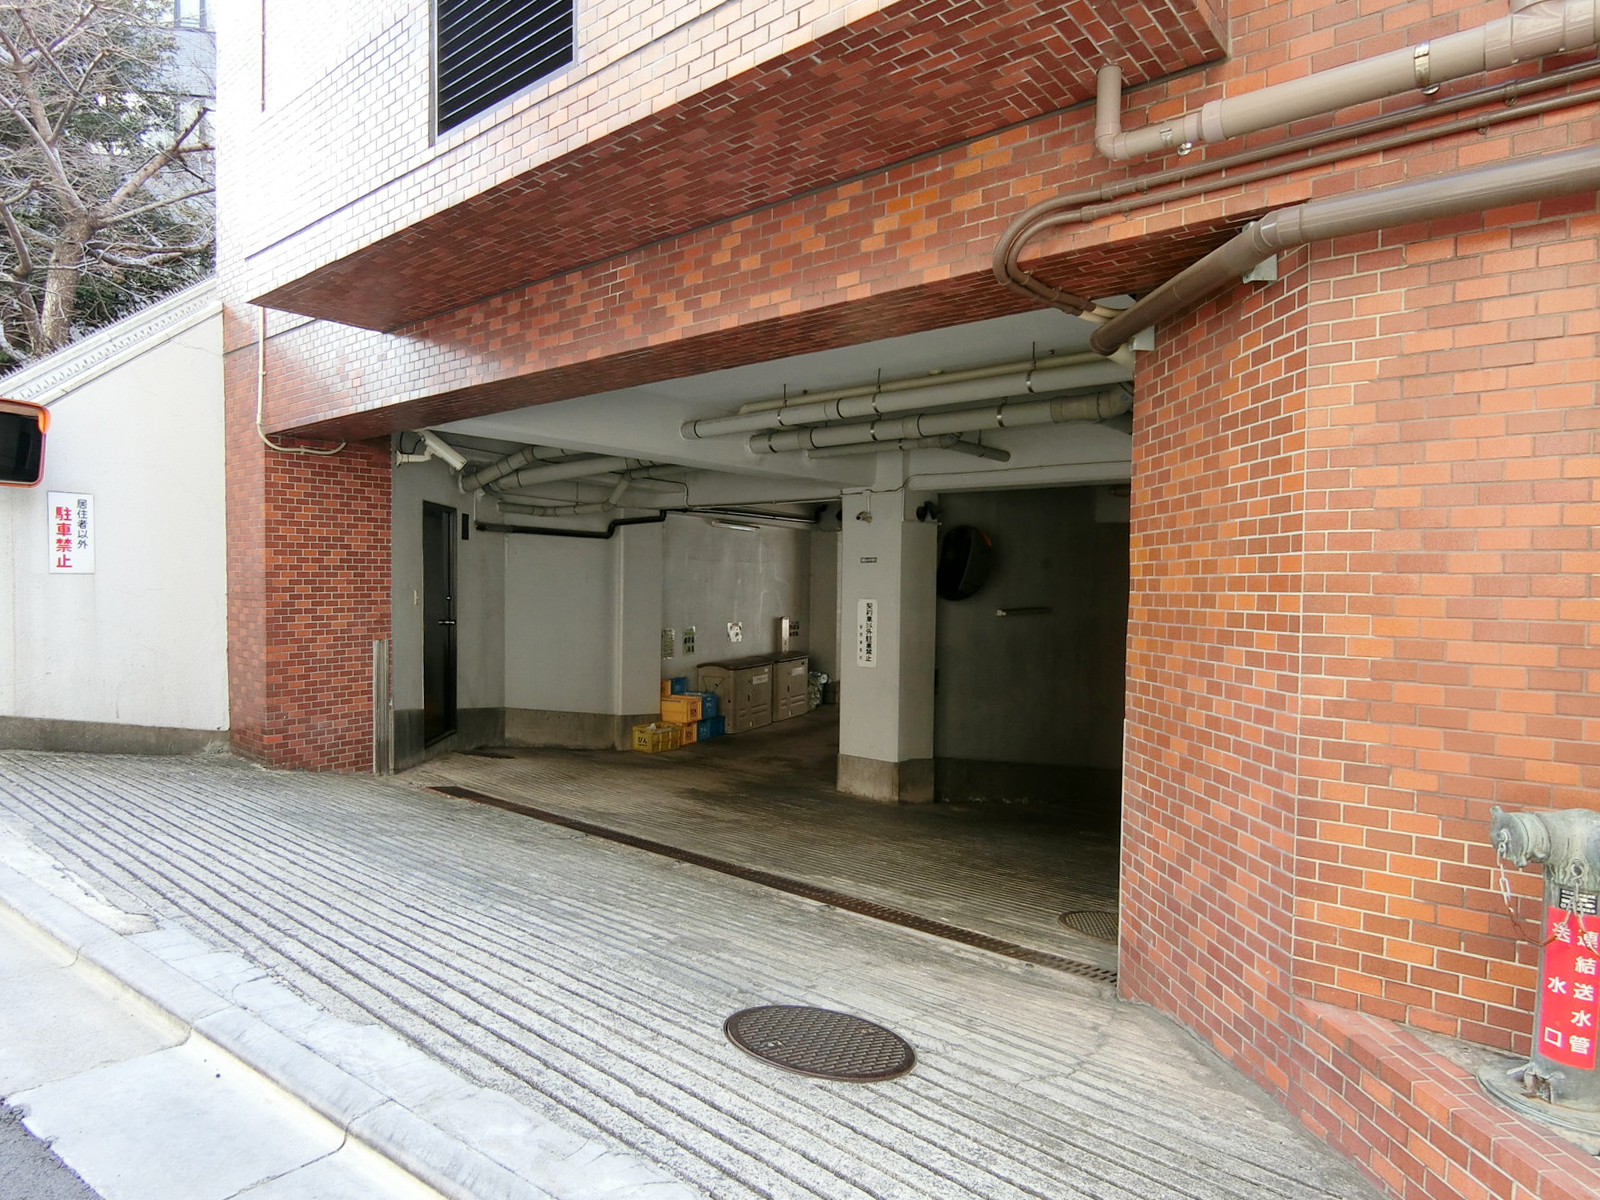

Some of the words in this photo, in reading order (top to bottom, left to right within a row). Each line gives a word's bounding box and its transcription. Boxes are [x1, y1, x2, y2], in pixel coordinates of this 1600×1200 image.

[55, 506, 73, 568] 駐車禁止
[77, 499, 88, 549] 居住者以外
[1544, 922, 1571, 1047] 送水口
[1568, 928, 1599, 1055] 連結送水管
